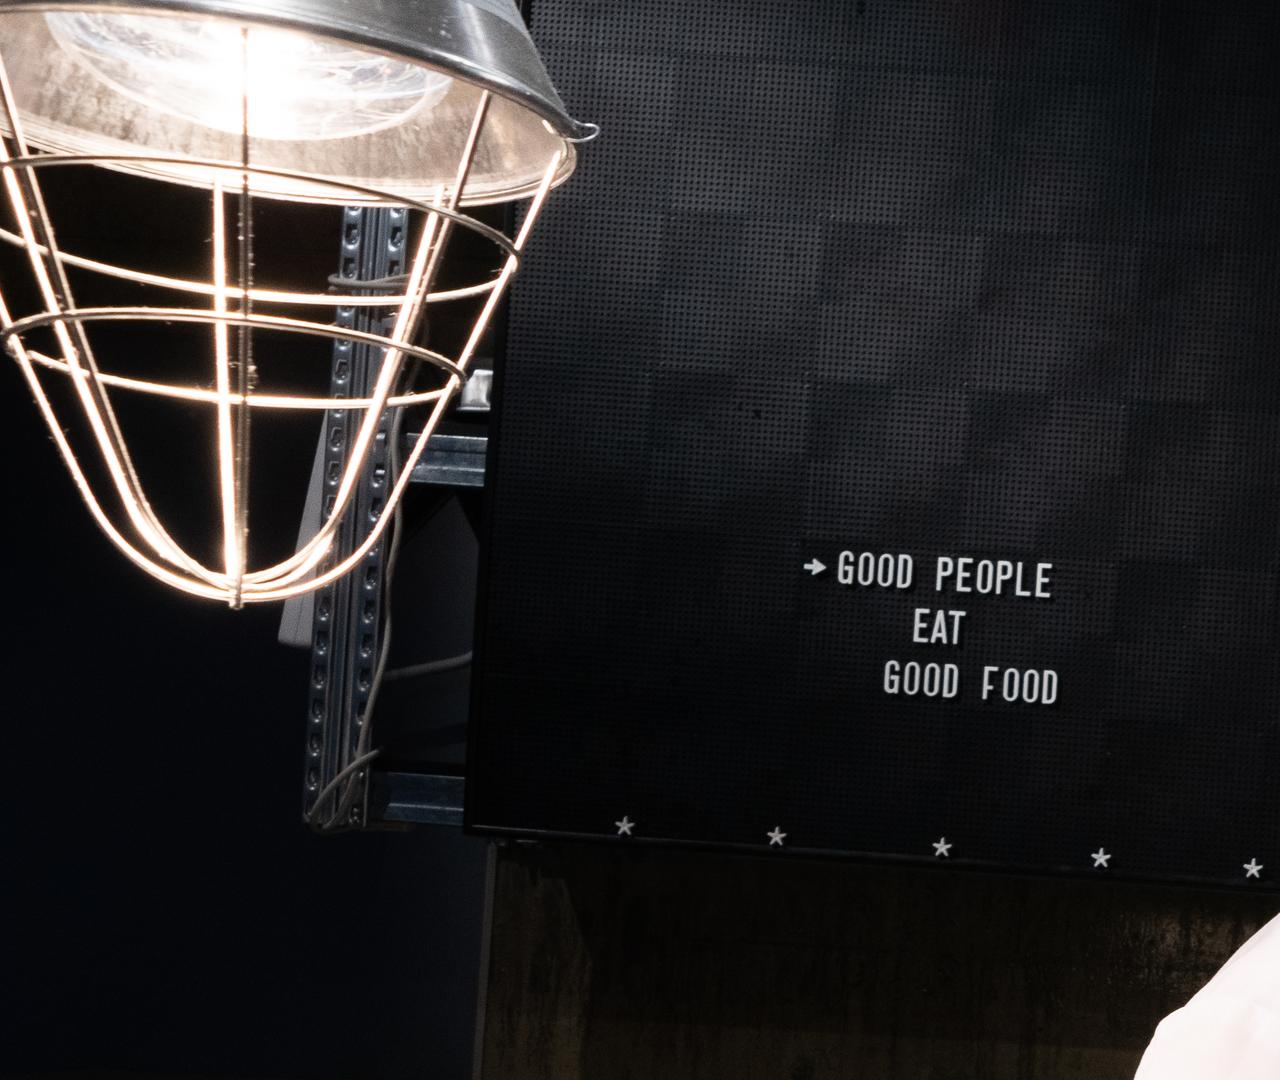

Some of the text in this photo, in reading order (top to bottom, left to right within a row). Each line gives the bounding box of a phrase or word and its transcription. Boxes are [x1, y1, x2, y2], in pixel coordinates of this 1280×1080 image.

[837, 550, 1053, 598] GOOD PEOPLE
[912, 607, 966, 645] EAT
[883, 660, 1058, 705] GOOD FOOD
